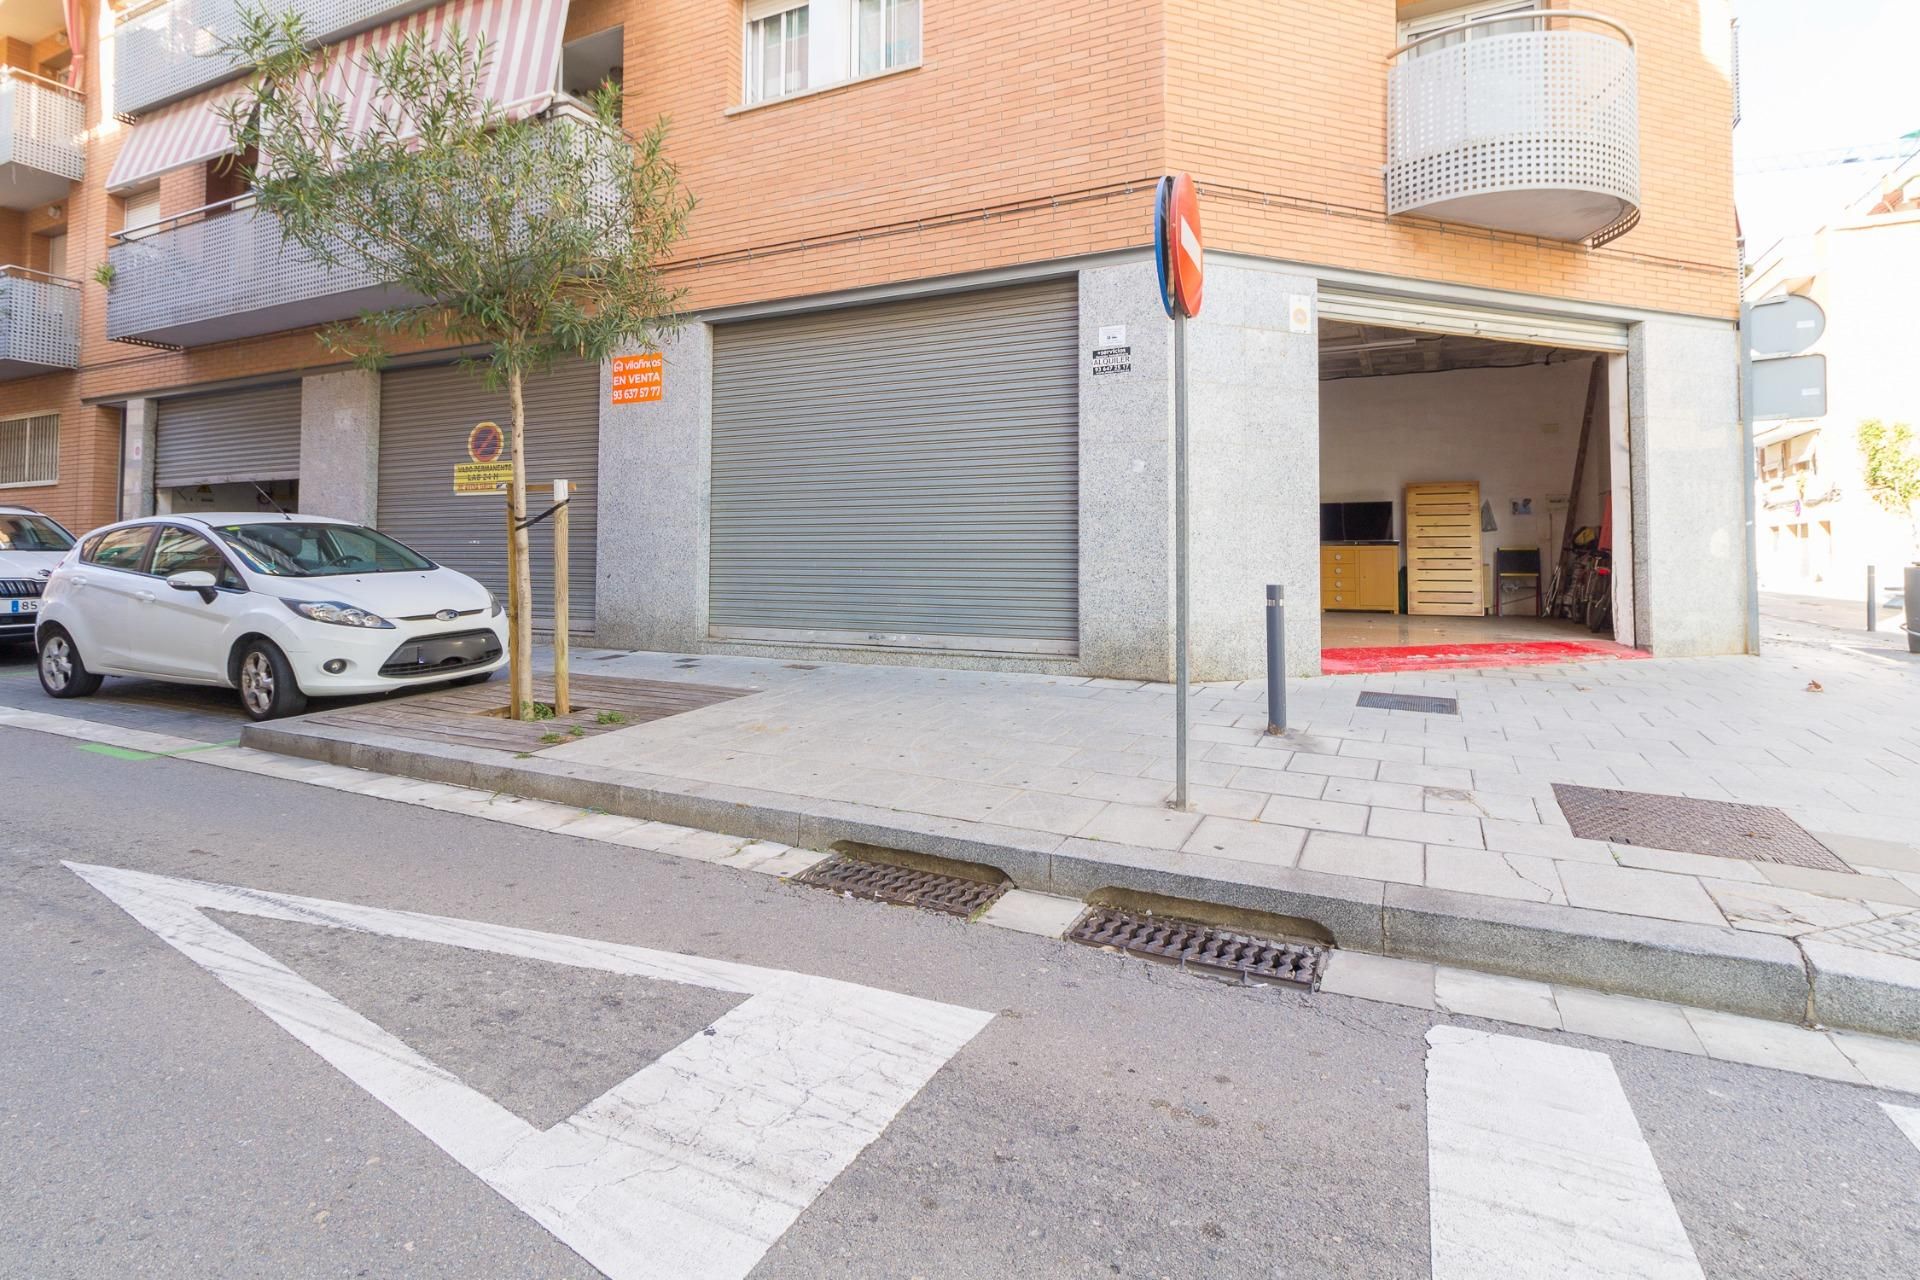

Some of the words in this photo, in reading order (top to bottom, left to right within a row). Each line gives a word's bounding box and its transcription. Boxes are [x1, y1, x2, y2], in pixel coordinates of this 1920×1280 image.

[1093, 356, 1130, 366] ALQUILER
[613, 376, 626, 386] EN
[628, 372, 660, 384] VENTA
[613, 390, 623, 400] 93
[624, 388, 638, 399] 637
[640, 387, 649, 398] 57
[650, 386, 660, 397] 77
